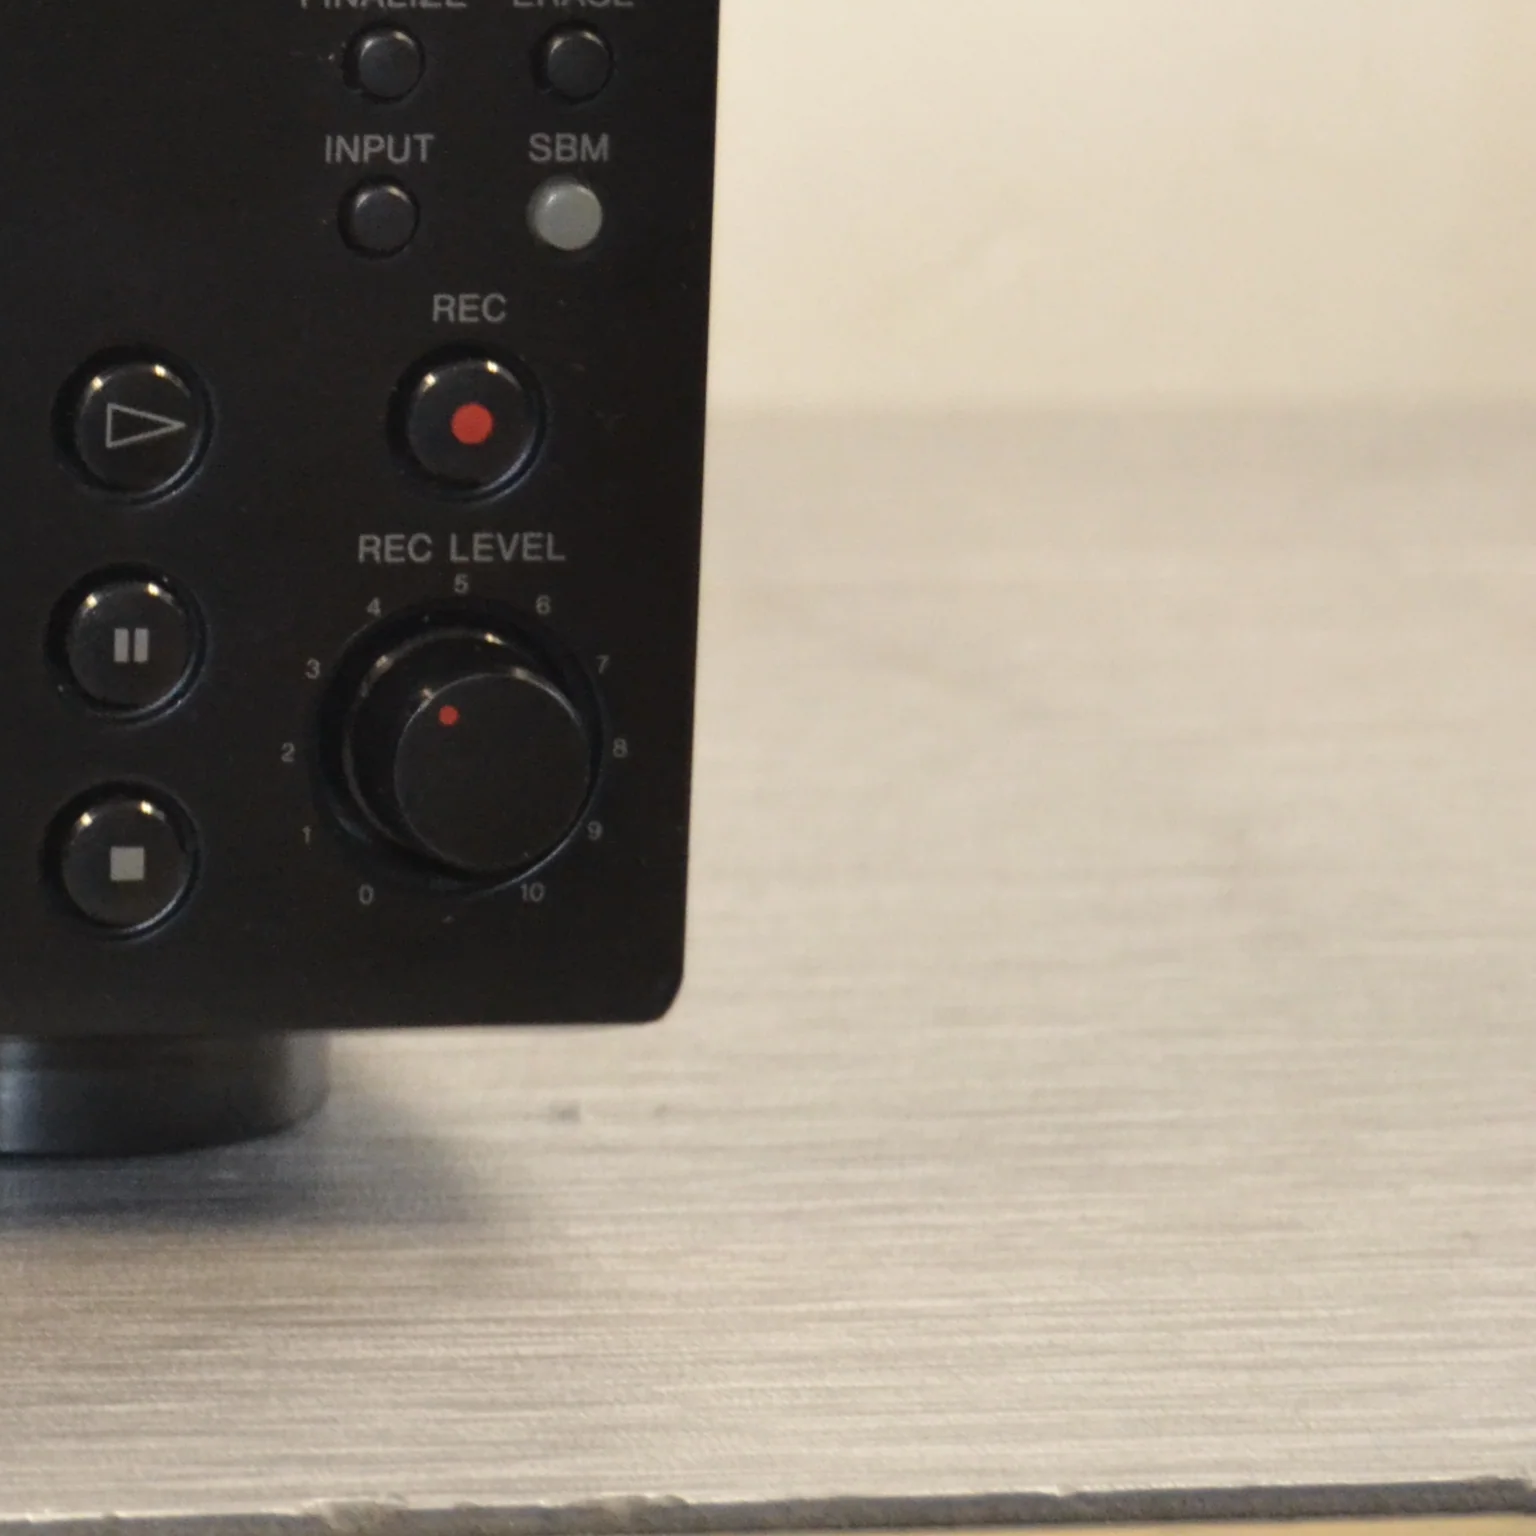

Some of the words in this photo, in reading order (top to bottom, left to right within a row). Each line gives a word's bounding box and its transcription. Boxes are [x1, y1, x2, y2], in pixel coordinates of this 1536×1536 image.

[325, 134, 434, 164] INPUT
[529, 133, 609, 162] SBM
[432, 293, 507, 322] REC
[358, 534, 432, 562] REC
[449, 533, 566, 561] LEVEL
[453, 575, 469, 594] 5
[366, 597, 381, 617] 4
[536, 595, 551, 615] 6
[305, 659, 320, 679] 3
[596, 655, 610, 674] 7
[280, 743, 295, 763] 2
[613, 738, 627, 758] 8
[302, 825, 311, 843] 1
[587, 820, 603, 841] 9
[359, 884, 374, 904] 0
[520, 882, 545, 902] 10
